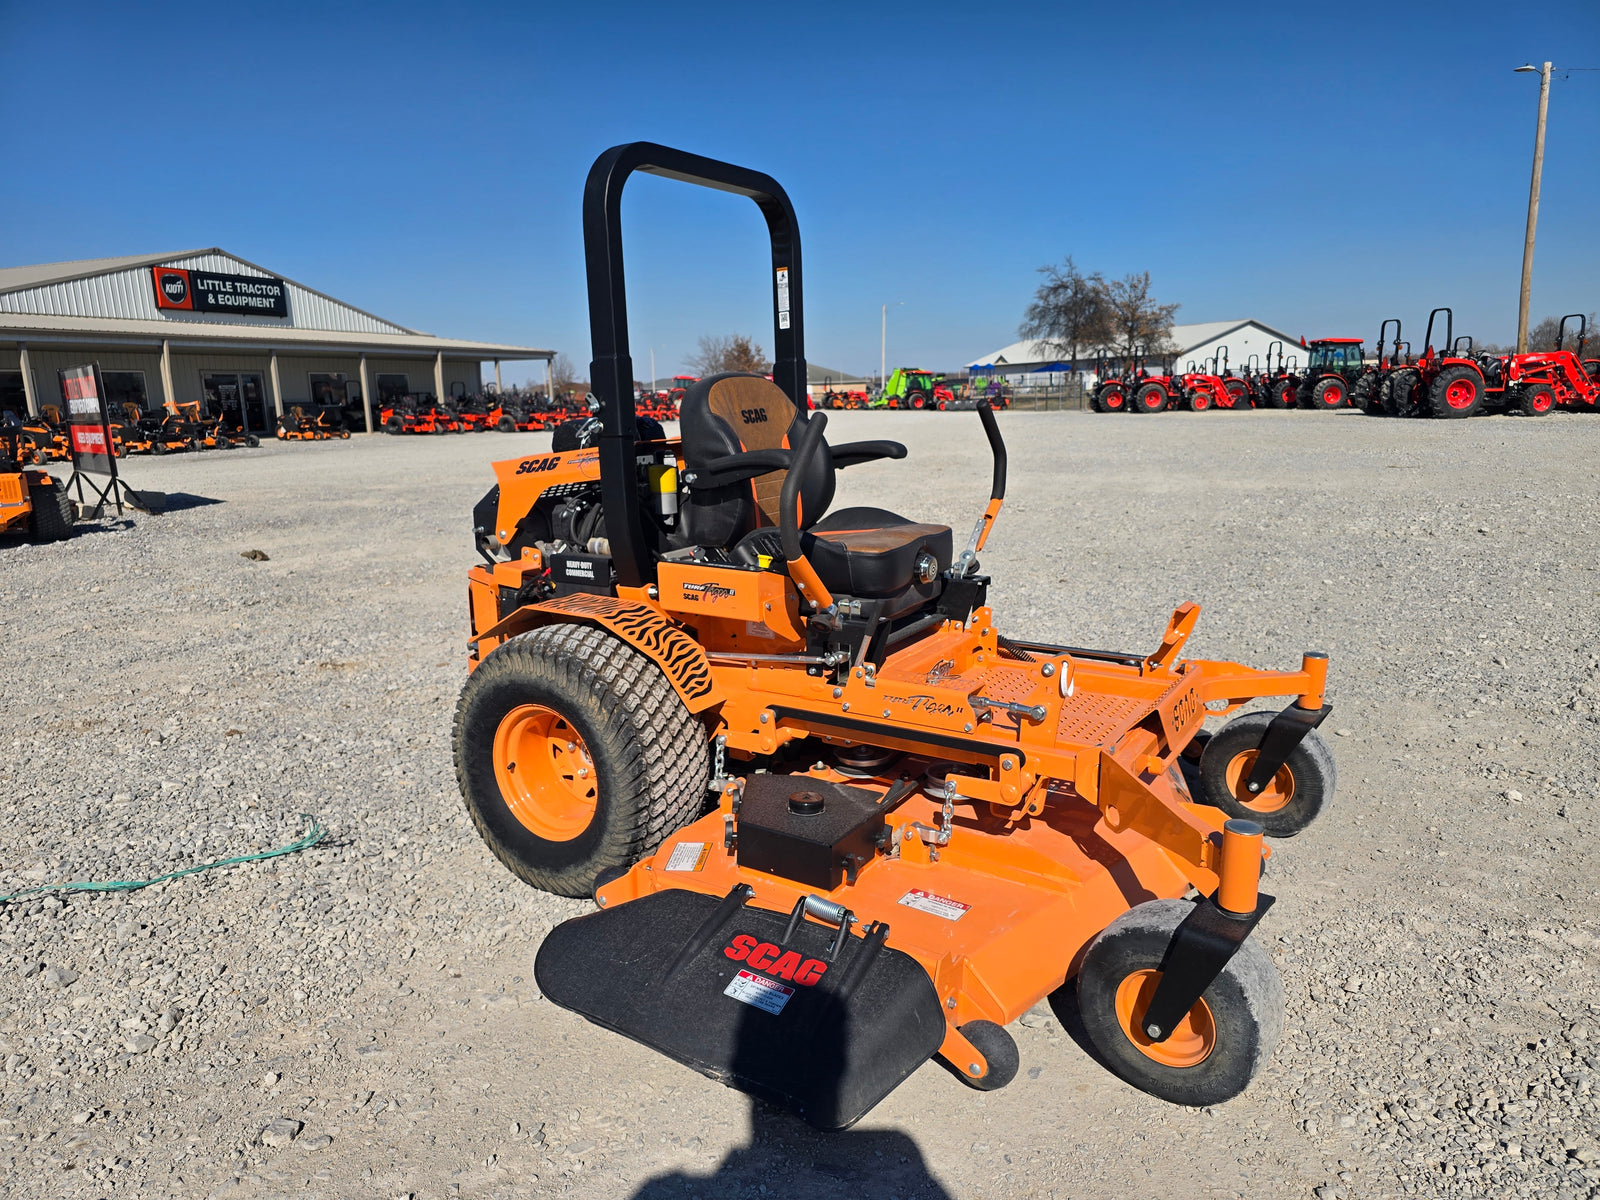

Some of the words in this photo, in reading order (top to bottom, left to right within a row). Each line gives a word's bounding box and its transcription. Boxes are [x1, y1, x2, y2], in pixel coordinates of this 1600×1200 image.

[197, 279, 234, 292] LITTLE
[235, 282, 281, 296] TRACTOR
[207, 293, 216, 304] &
[217, 294, 276, 308] EQUIPMENT
[741, 408, 768, 424] SCAG
[516, 457, 561, 474] SCAG
[566, 560, 593, 569] HEAVY-DUTY
[565, 569, 594, 578] COMMERCIAL
[683, 583, 706, 592] TURF
[701, 583, 729, 603] Tiger
[683, 593, 699, 601] SCAG
[927, 894, 965, 909] DANGER
[723, 934, 828, 987] SCAG
[754, 976, 785, 993] DANGER
